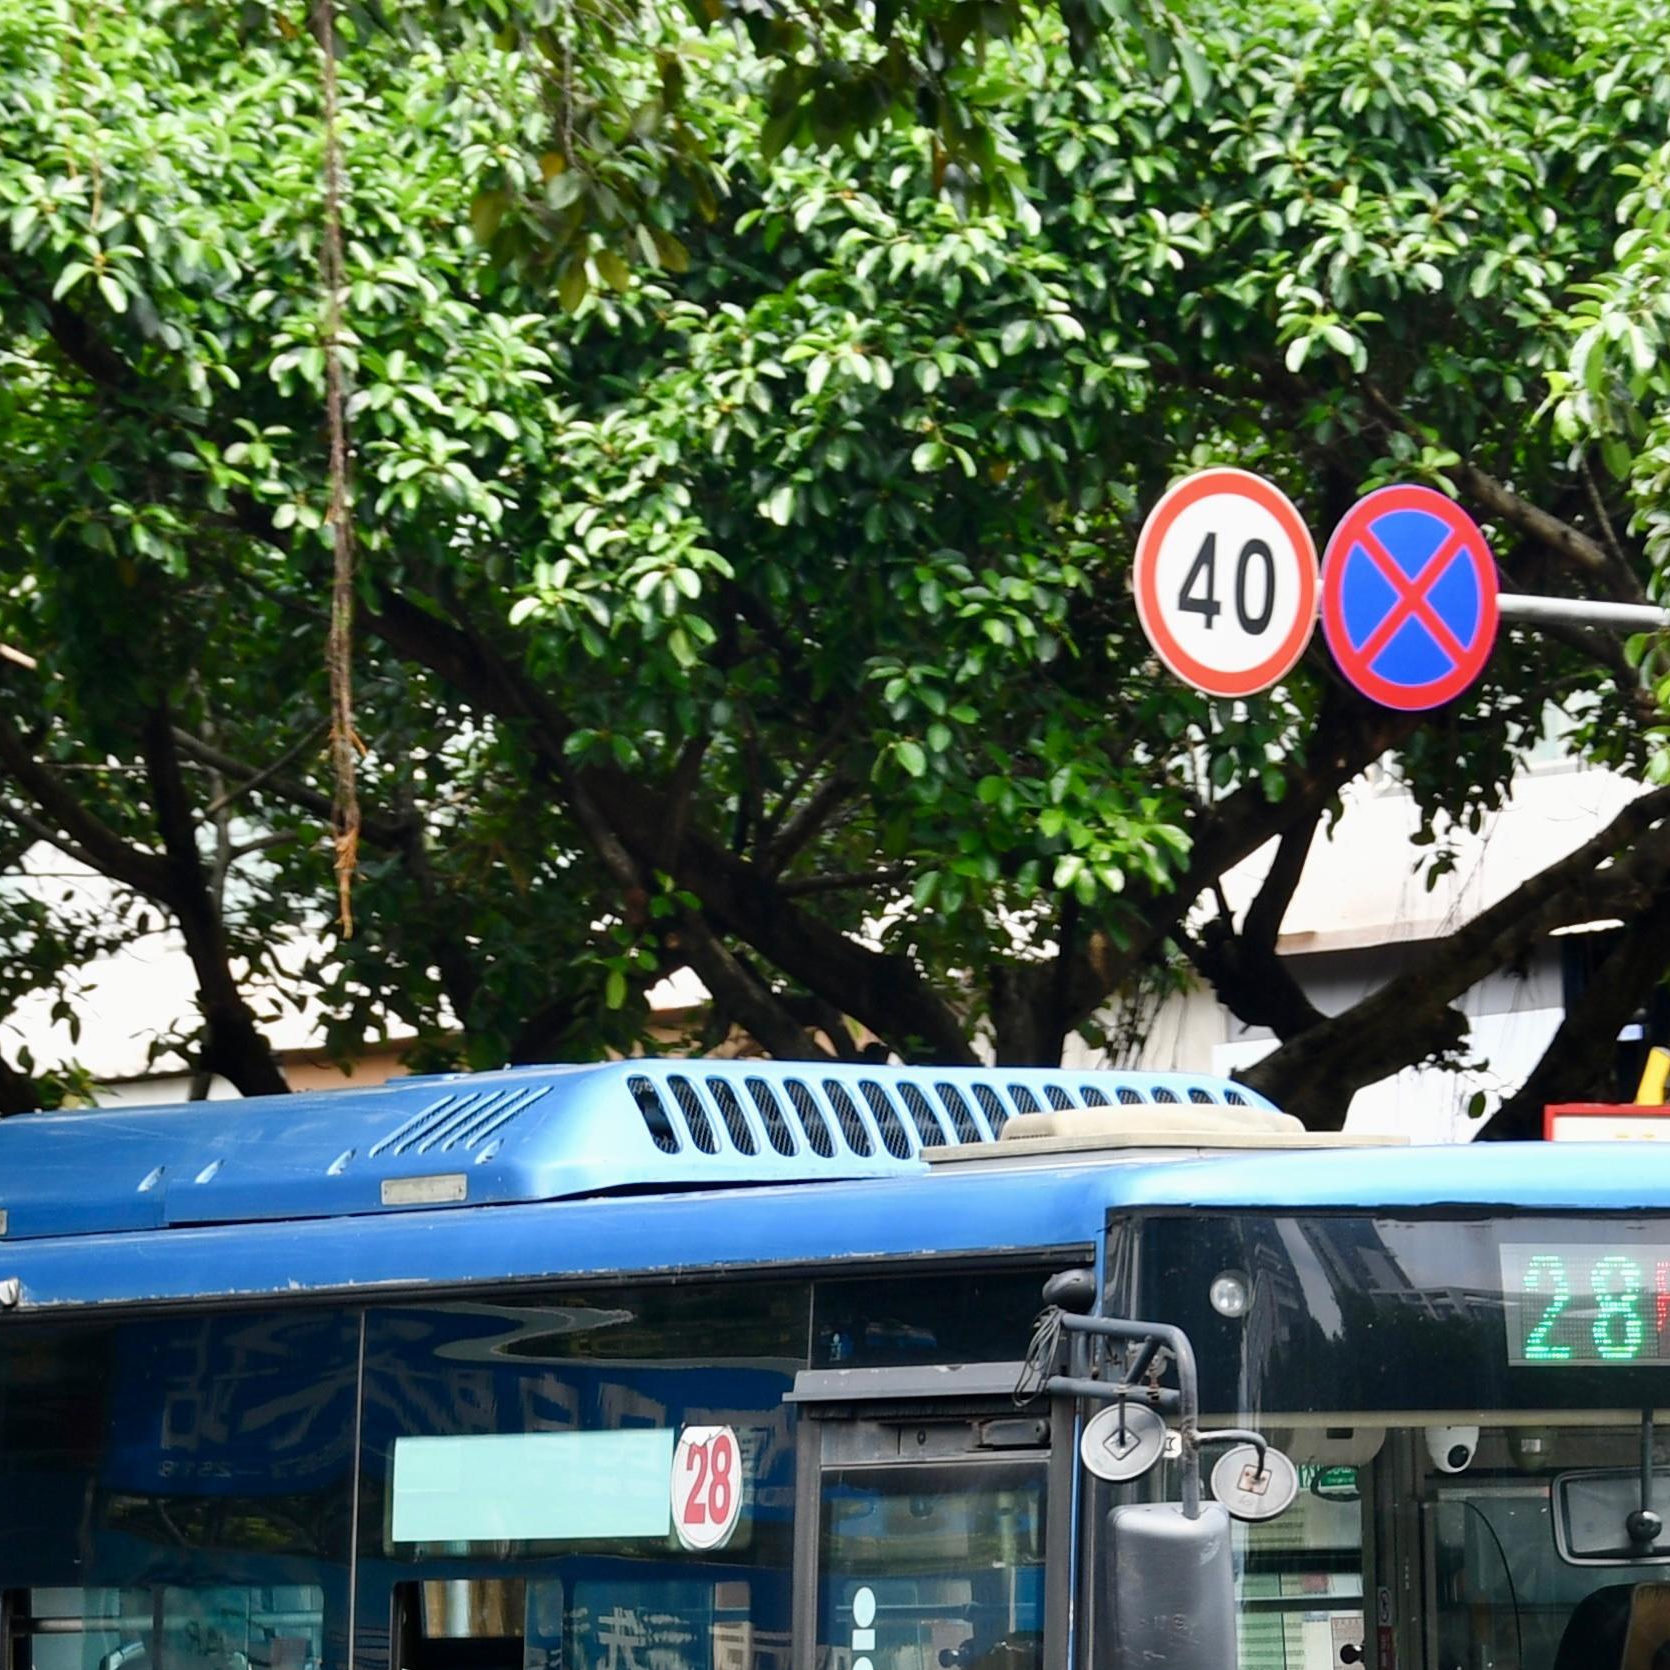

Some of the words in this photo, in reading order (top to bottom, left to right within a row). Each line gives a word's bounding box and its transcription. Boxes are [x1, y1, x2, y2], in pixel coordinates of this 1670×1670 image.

[1177, 531, 1276, 637] 40
[1524, 1255, 1644, 1360] 28
[682, 1434, 732, 1526] 28
